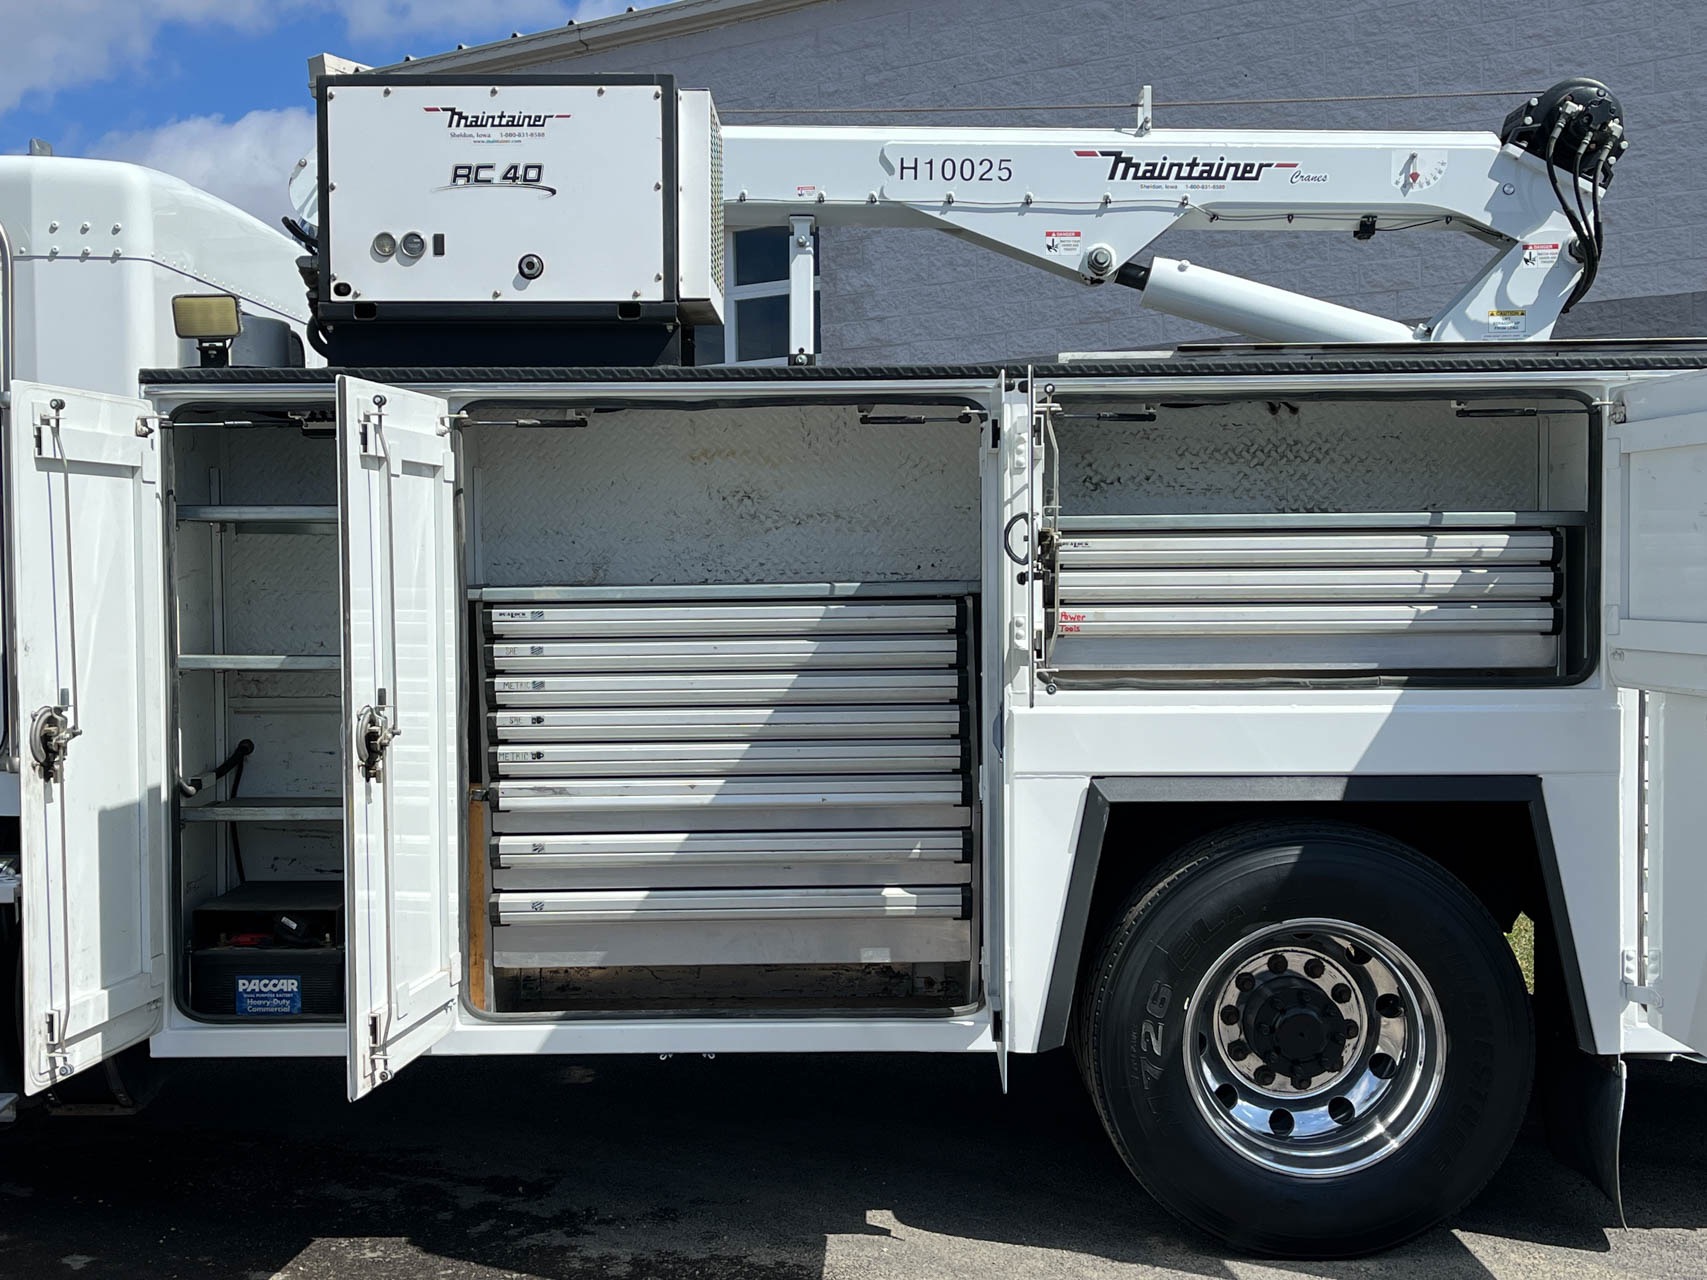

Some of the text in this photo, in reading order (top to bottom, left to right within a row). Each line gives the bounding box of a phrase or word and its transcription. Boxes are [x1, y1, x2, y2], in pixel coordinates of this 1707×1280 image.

[440, 107, 554, 128] Maintainer
[899, 157, 1013, 182] H10025
[1098, 151, 1274, 181] Maintainer
[451, 163, 545, 185] RC 40
[1289, 170, 1328, 184] Cranes
[1060, 612, 1086, 621] Power
[503, 681, 531, 690] METRIC
[498, 752, 528, 761] METRIC
[238, 979, 298, 992] PACCAR
[247, 998, 290, 1006] Heavy-Duty
